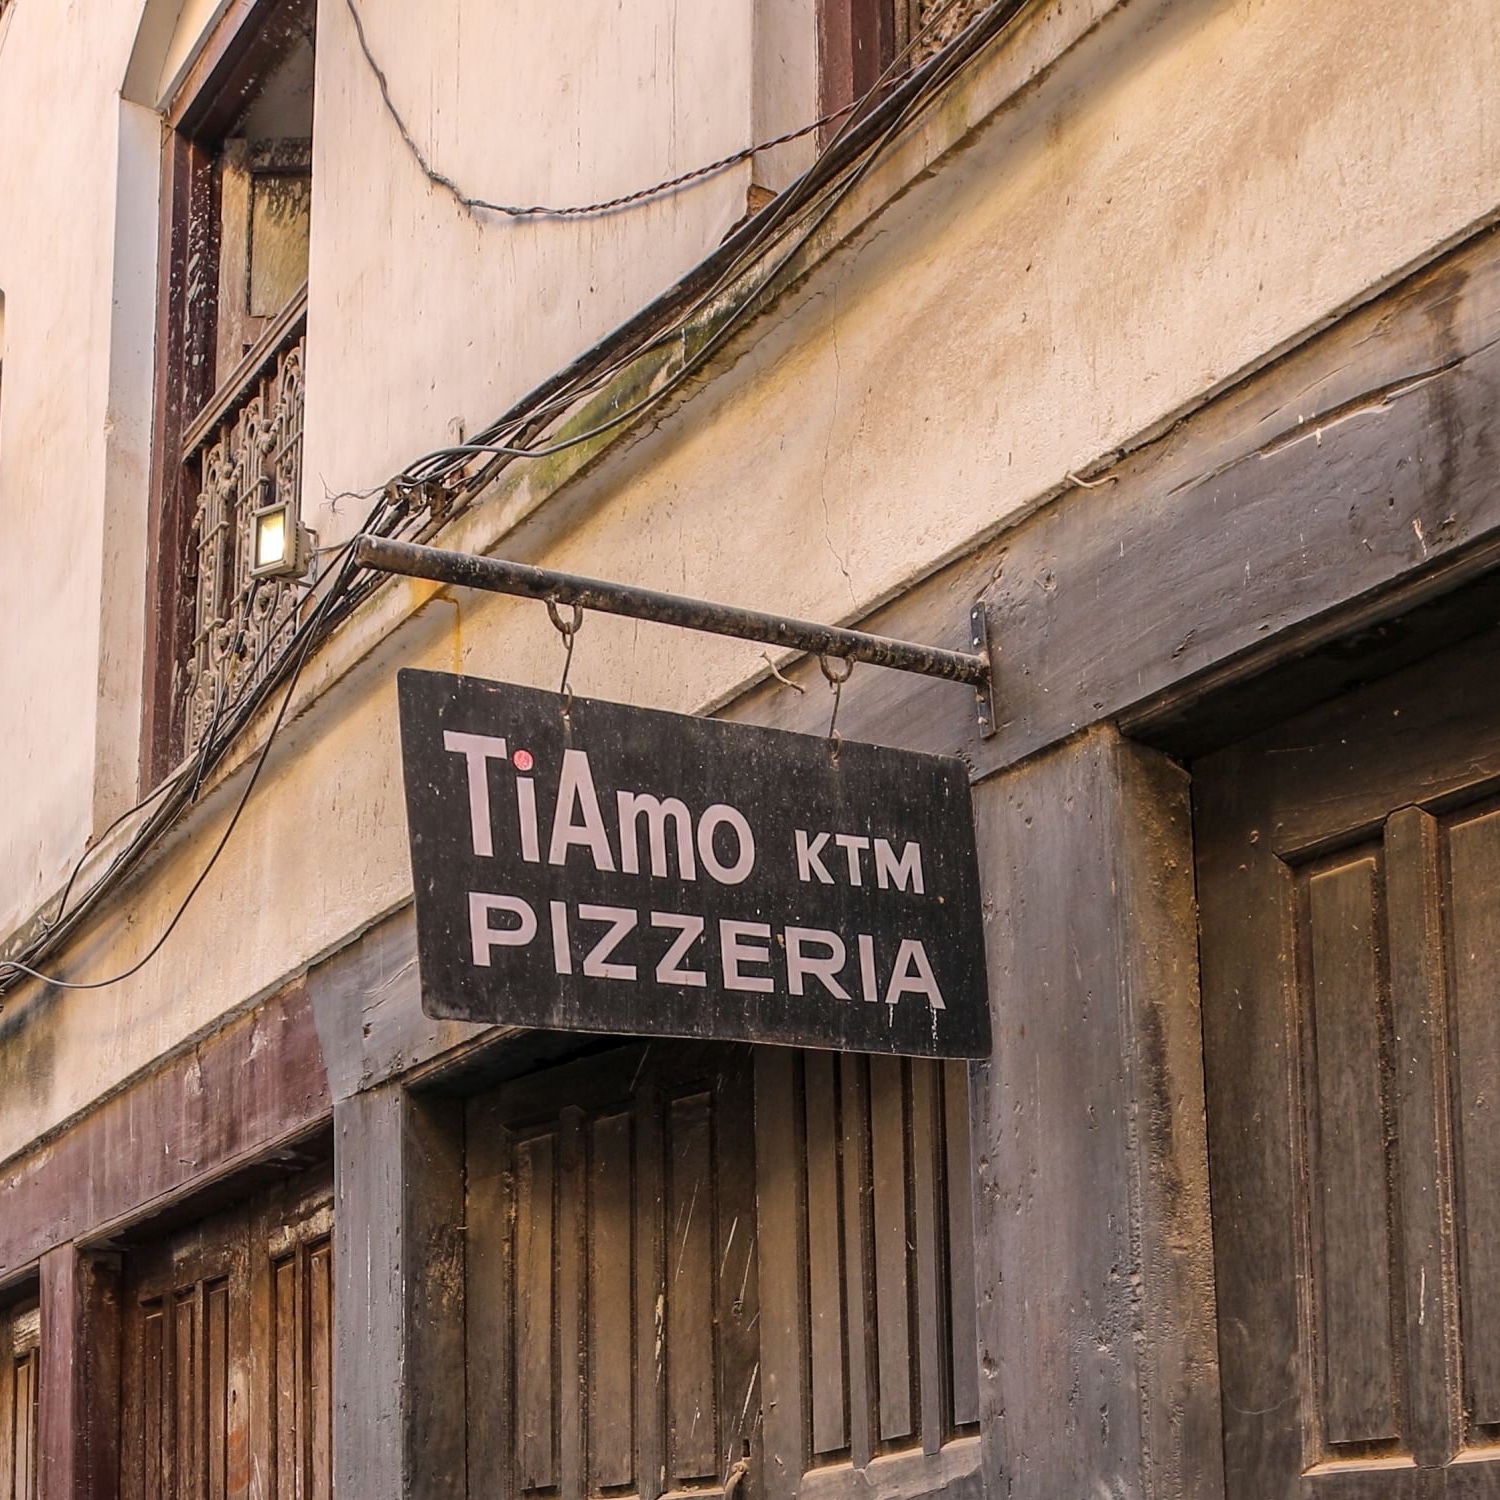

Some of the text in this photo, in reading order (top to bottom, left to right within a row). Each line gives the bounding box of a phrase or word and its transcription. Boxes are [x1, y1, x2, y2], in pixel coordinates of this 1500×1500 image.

[443, 730, 926, 895] TiAmo KTM
[467, 891, 947, 1010] PIZZERIA
